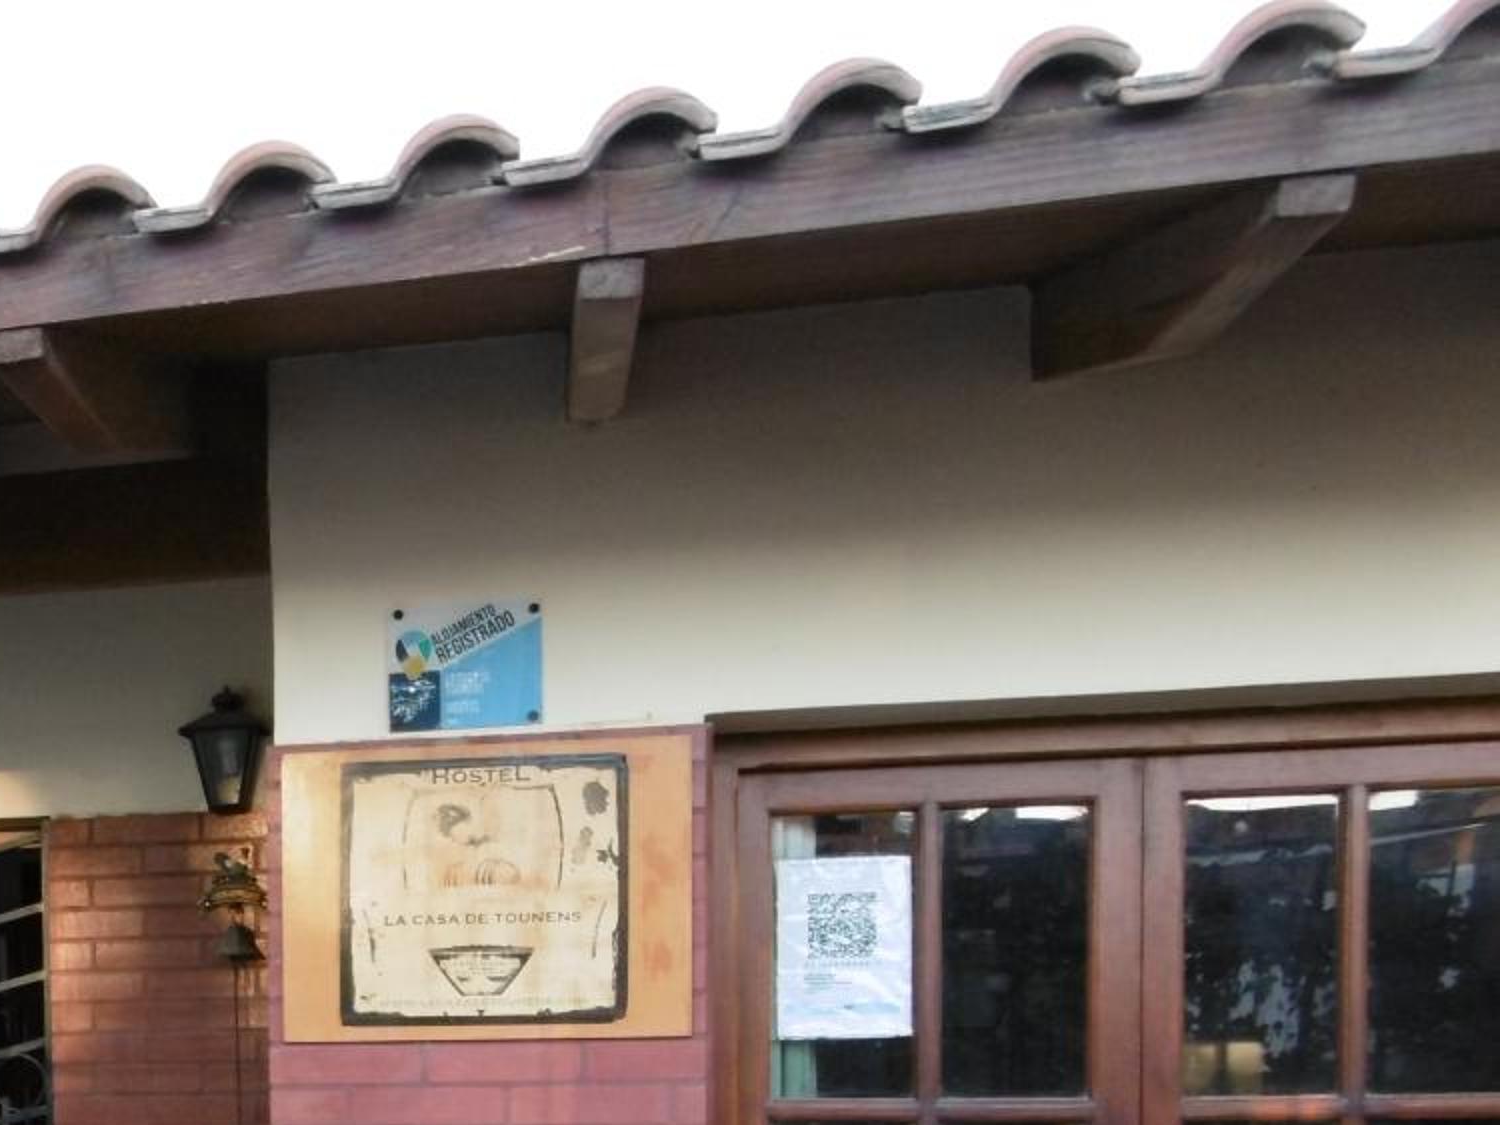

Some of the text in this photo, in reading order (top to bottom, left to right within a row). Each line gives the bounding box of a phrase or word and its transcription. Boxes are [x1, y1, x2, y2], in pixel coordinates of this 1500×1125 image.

[431, 607, 497, 644] ALOJAMIENTO
[436, 610, 515, 663] REGISTRADO
[432, 765, 531, 784] HOSTEL
[384, 910, 581, 927] LA CASA DE TOUNENS
